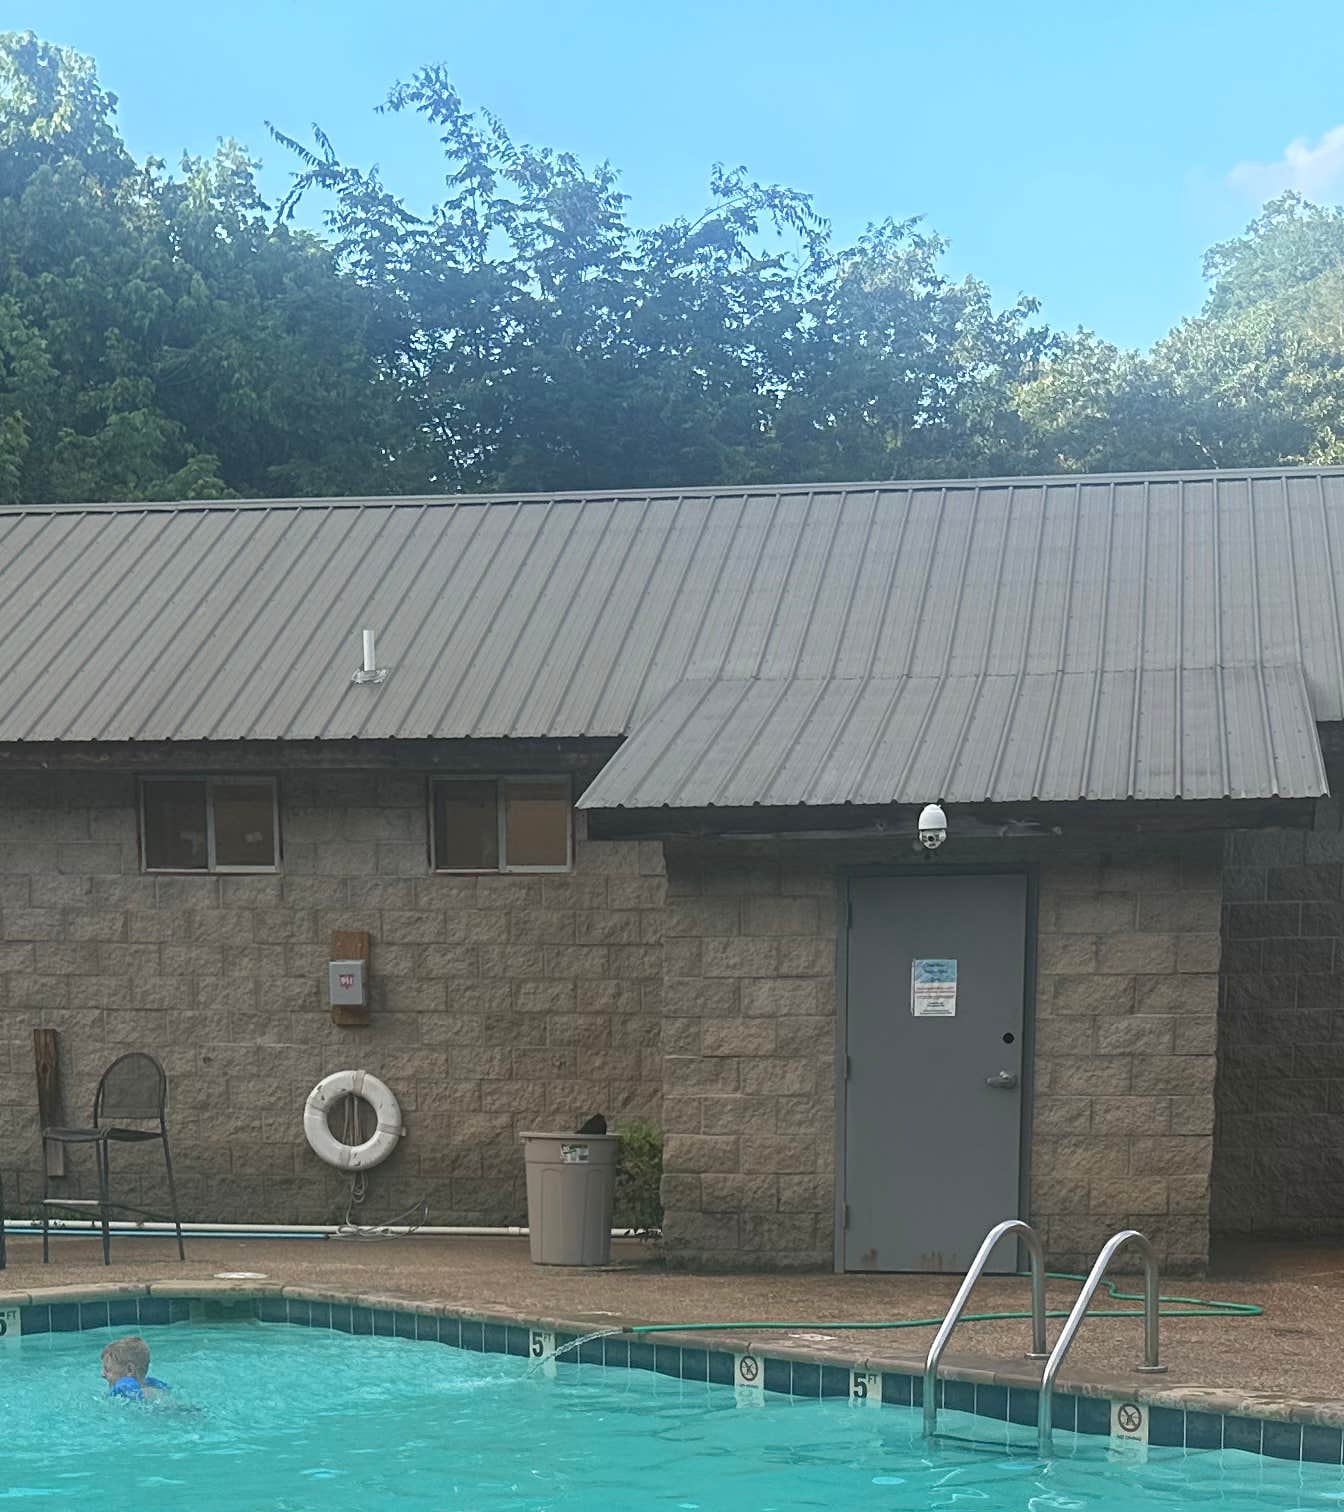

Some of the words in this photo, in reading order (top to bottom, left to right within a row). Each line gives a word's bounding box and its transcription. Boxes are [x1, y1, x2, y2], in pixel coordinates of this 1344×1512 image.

[7, 1310, 17, 1320] FT
[532, 1331, 544, 1358] 5
[853, 1372, 868, 1398] 5
[868, 1374, 878, 1384] FT
